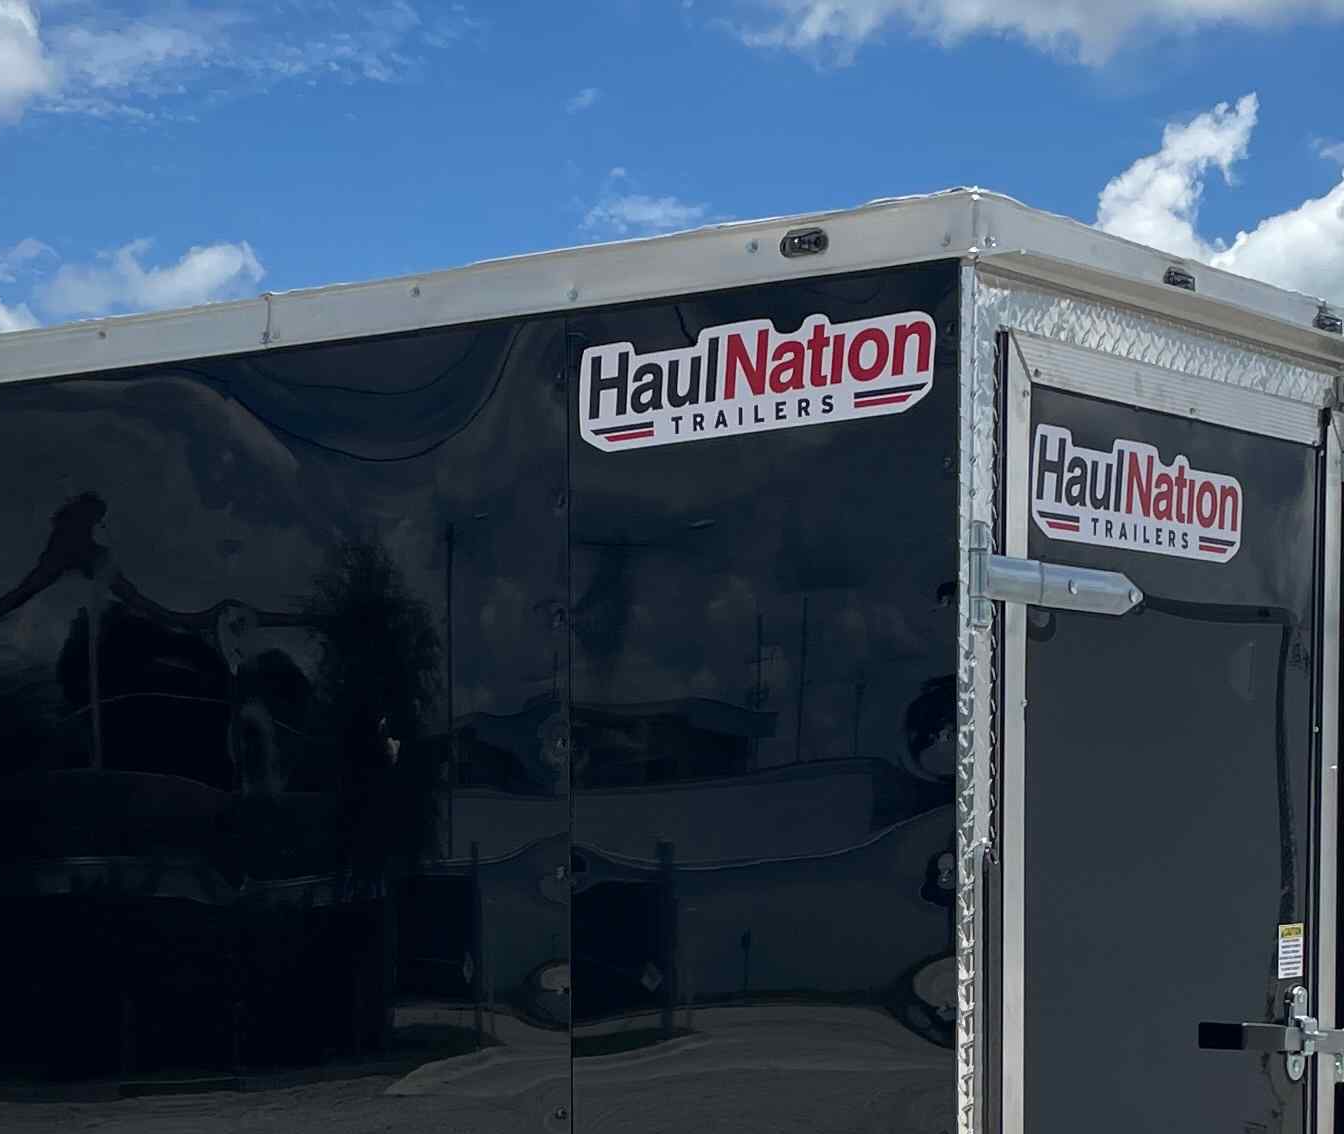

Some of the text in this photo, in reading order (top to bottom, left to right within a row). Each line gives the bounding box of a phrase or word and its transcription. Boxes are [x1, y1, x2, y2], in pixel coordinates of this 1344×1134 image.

[589, 321, 931, 420] HaulNation
[671, 394, 834, 434] TRAILERS
[1036, 434, 1238, 532] HaulNation
[1092, 517, 1190, 549] TRAILERS
